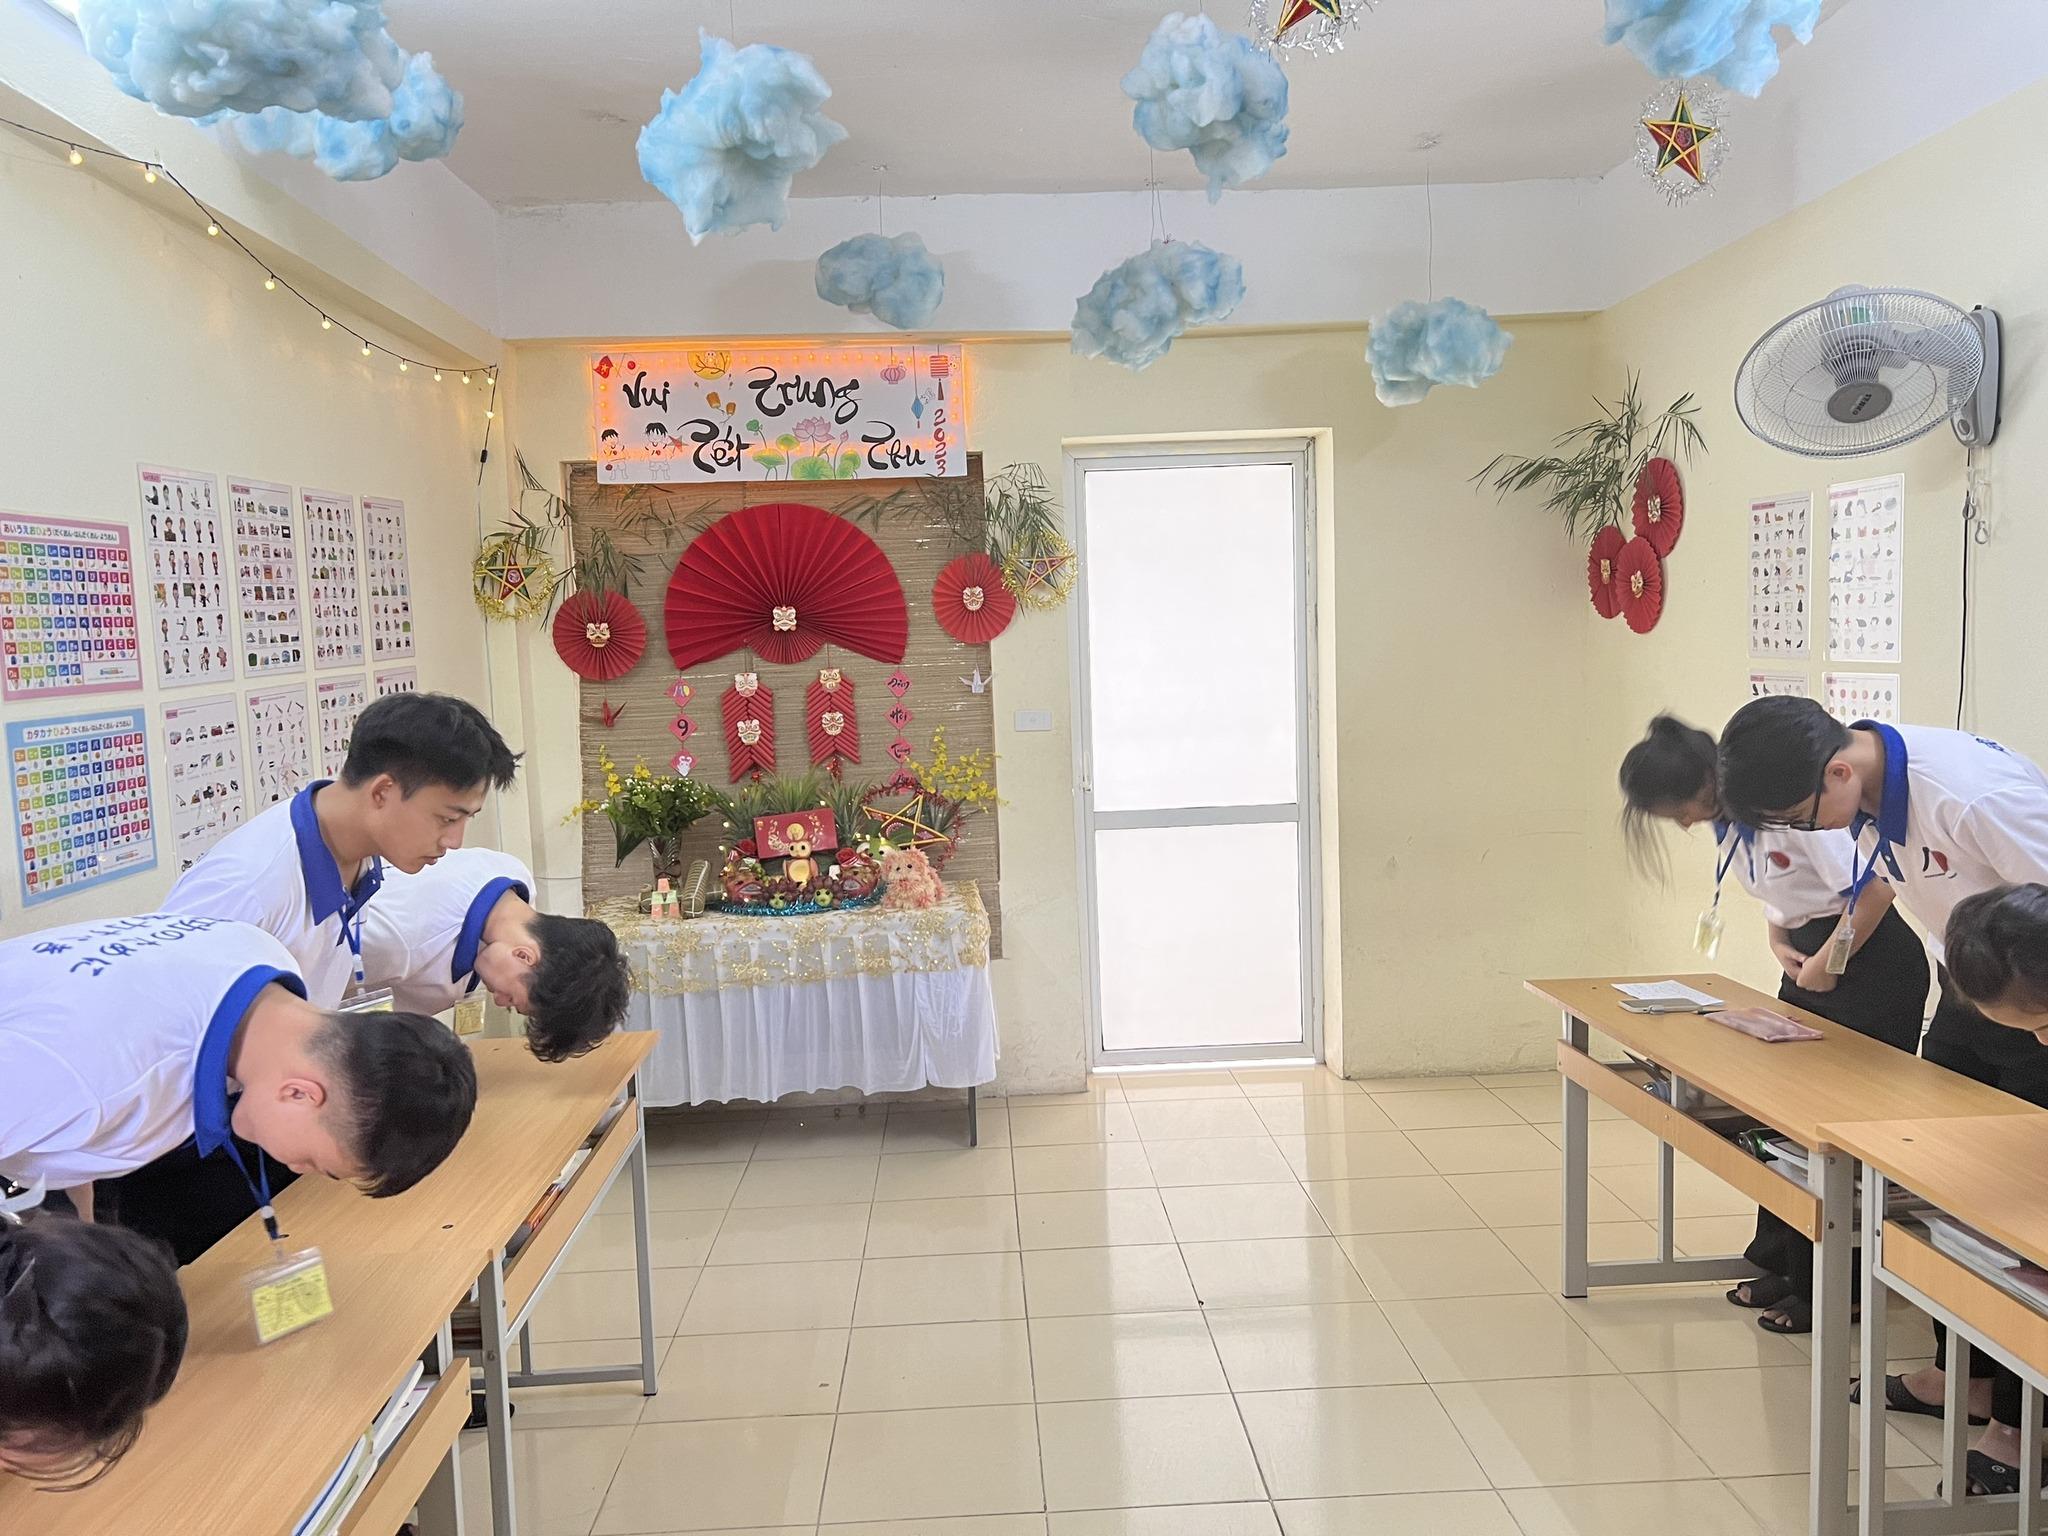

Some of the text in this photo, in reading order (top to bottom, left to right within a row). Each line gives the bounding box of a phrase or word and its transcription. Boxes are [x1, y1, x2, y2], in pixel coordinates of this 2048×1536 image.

[622, 366, 863, 425] Vui Trung
[677, 418, 926, 474] Tết Thu
[933, 408, 947, 477] 2023
[677, 719, 689, 737] 9
[70, 917, 234, 977] 功のために
